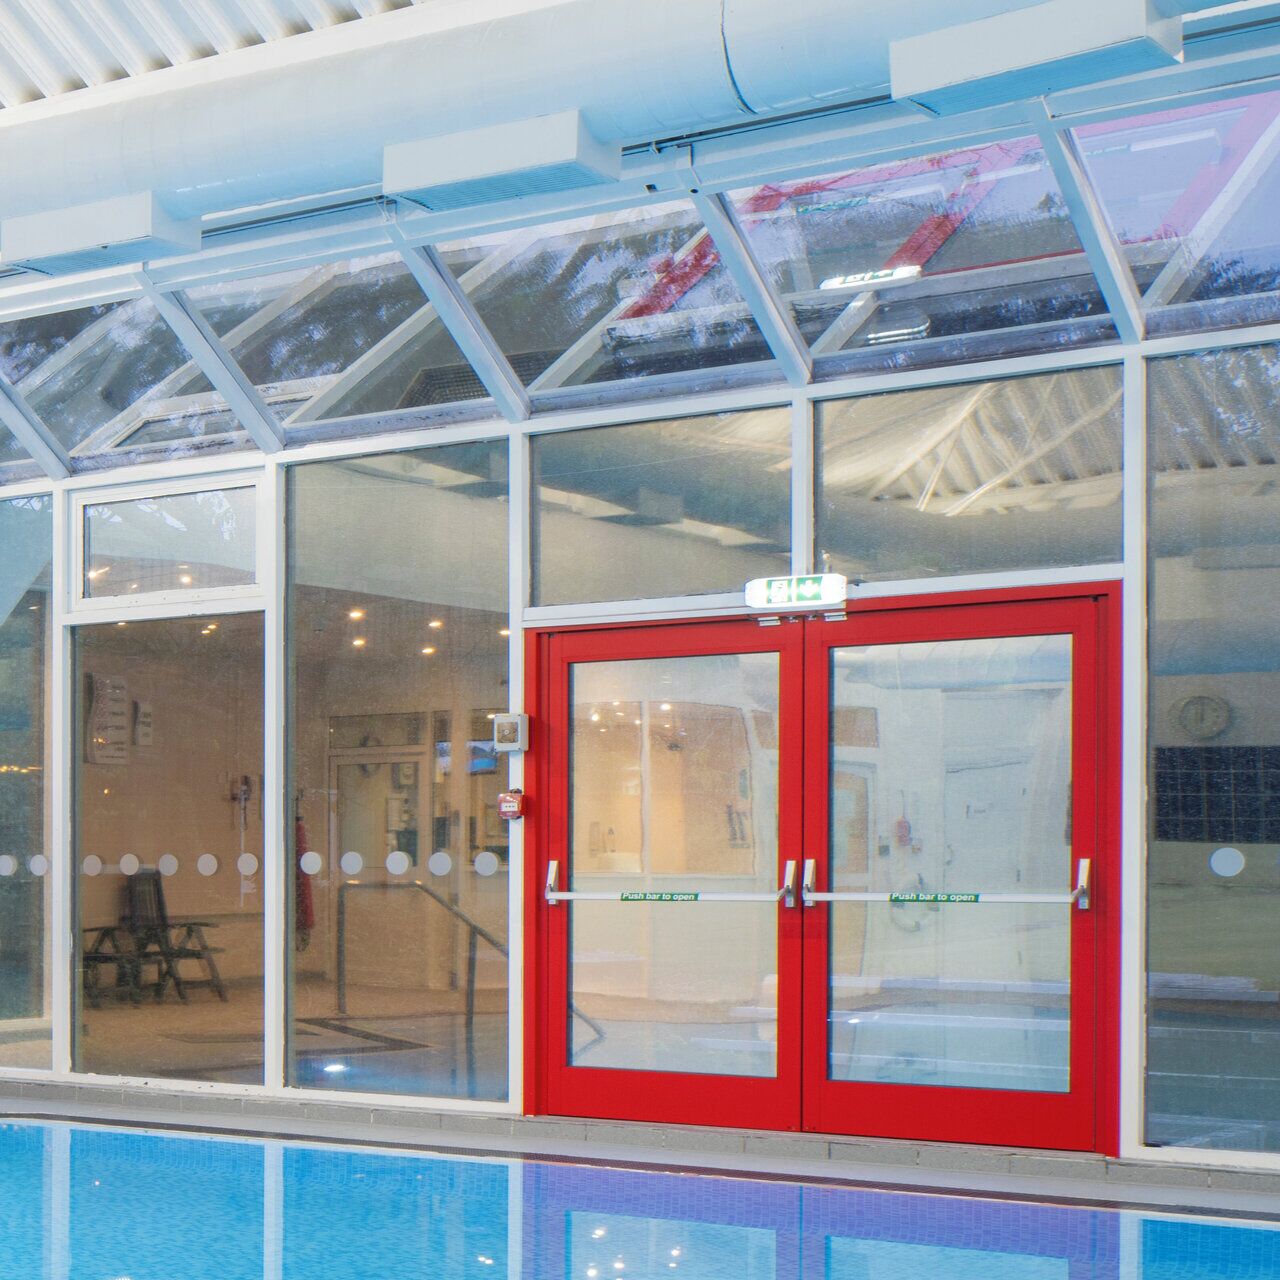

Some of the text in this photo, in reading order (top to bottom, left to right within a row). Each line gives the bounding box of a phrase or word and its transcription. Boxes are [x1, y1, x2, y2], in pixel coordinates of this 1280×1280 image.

[622, 892, 644, 900] Push
[672, 894, 695, 902] open
[891, 892, 917, 900] Push
[949, 894, 976, 902] open
